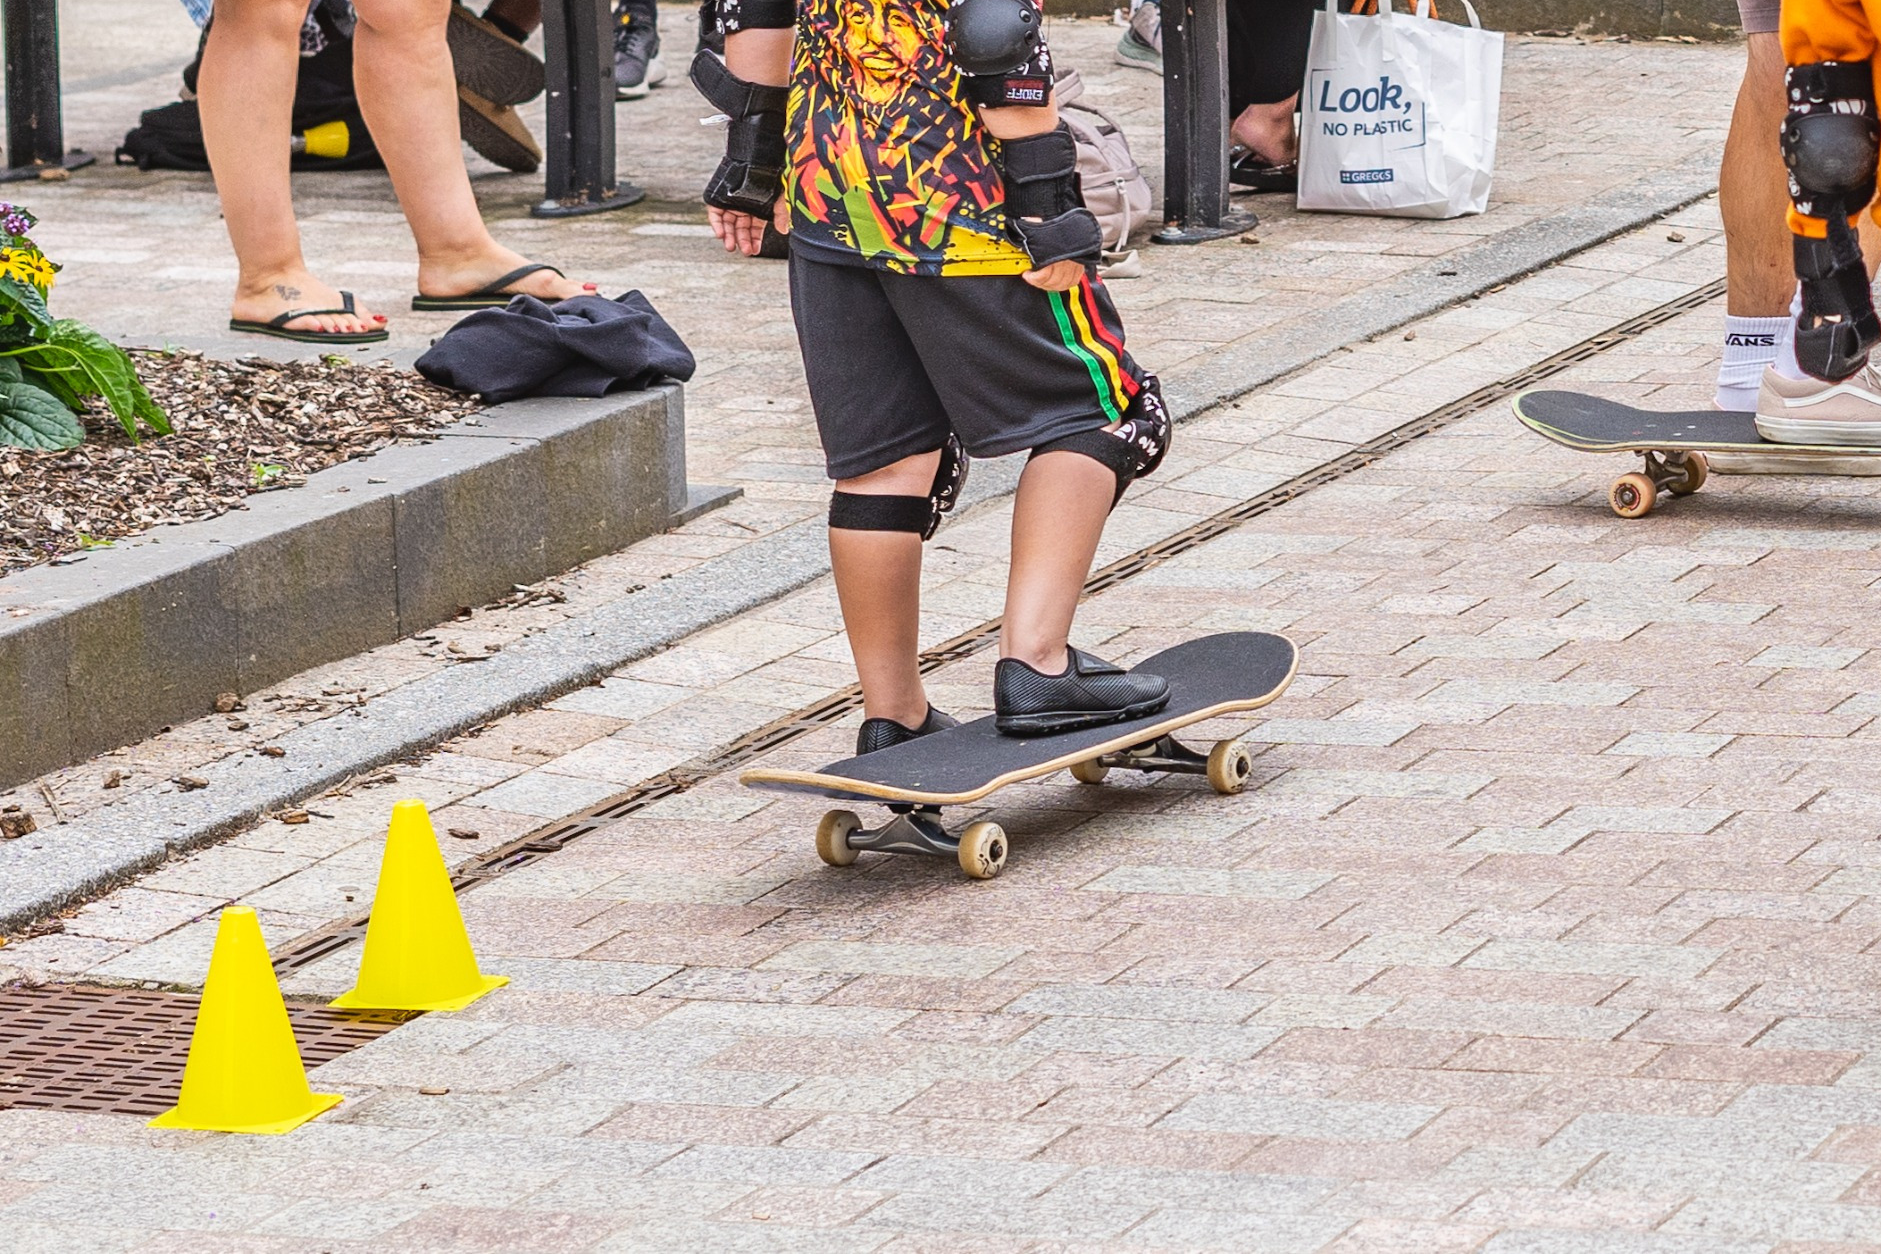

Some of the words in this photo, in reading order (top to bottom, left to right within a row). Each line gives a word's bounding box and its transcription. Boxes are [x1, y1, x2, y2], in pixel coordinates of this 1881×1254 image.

[1319, 76, 1412, 115] Look,
[1323, 122, 1348, 136] NO
[1353, 118, 1413, 136] PLASTIC
